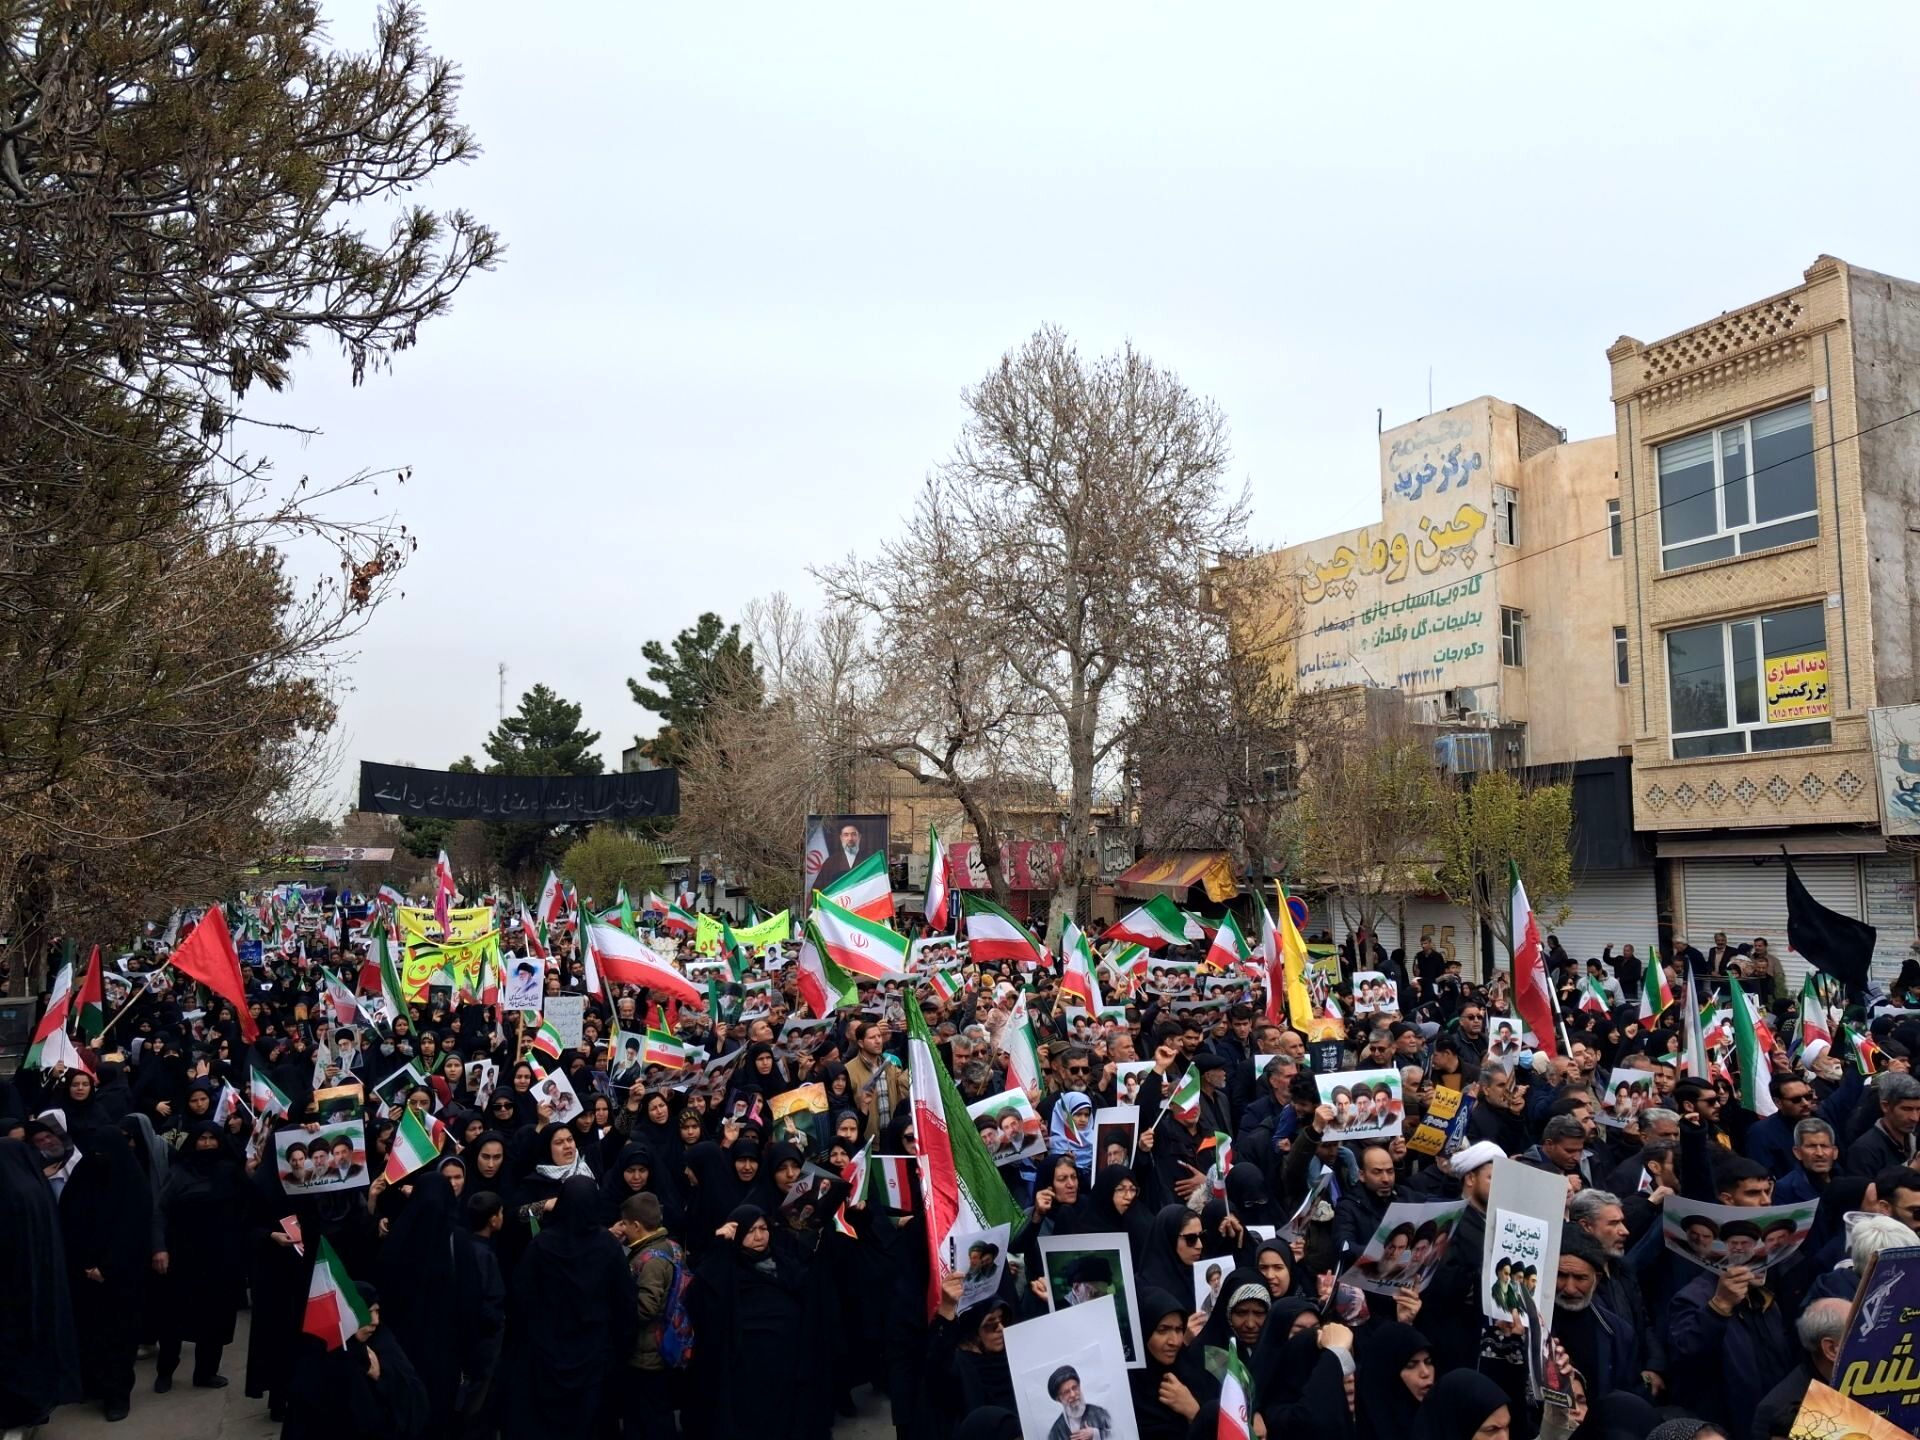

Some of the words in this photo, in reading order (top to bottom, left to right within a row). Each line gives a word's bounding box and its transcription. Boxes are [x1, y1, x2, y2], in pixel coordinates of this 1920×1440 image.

[1394, 453, 1437, 501] خرید
[1436, 443, 1482, 493] مرکز
[1415, 503, 1488, 574] چین
[1362, 601, 1389, 625] بازی
[1411, 618, 1428, 639] گل
[1433, 641, 1484, 663] دکورجات
[1768, 658, 1826, 682] دندانسازی
